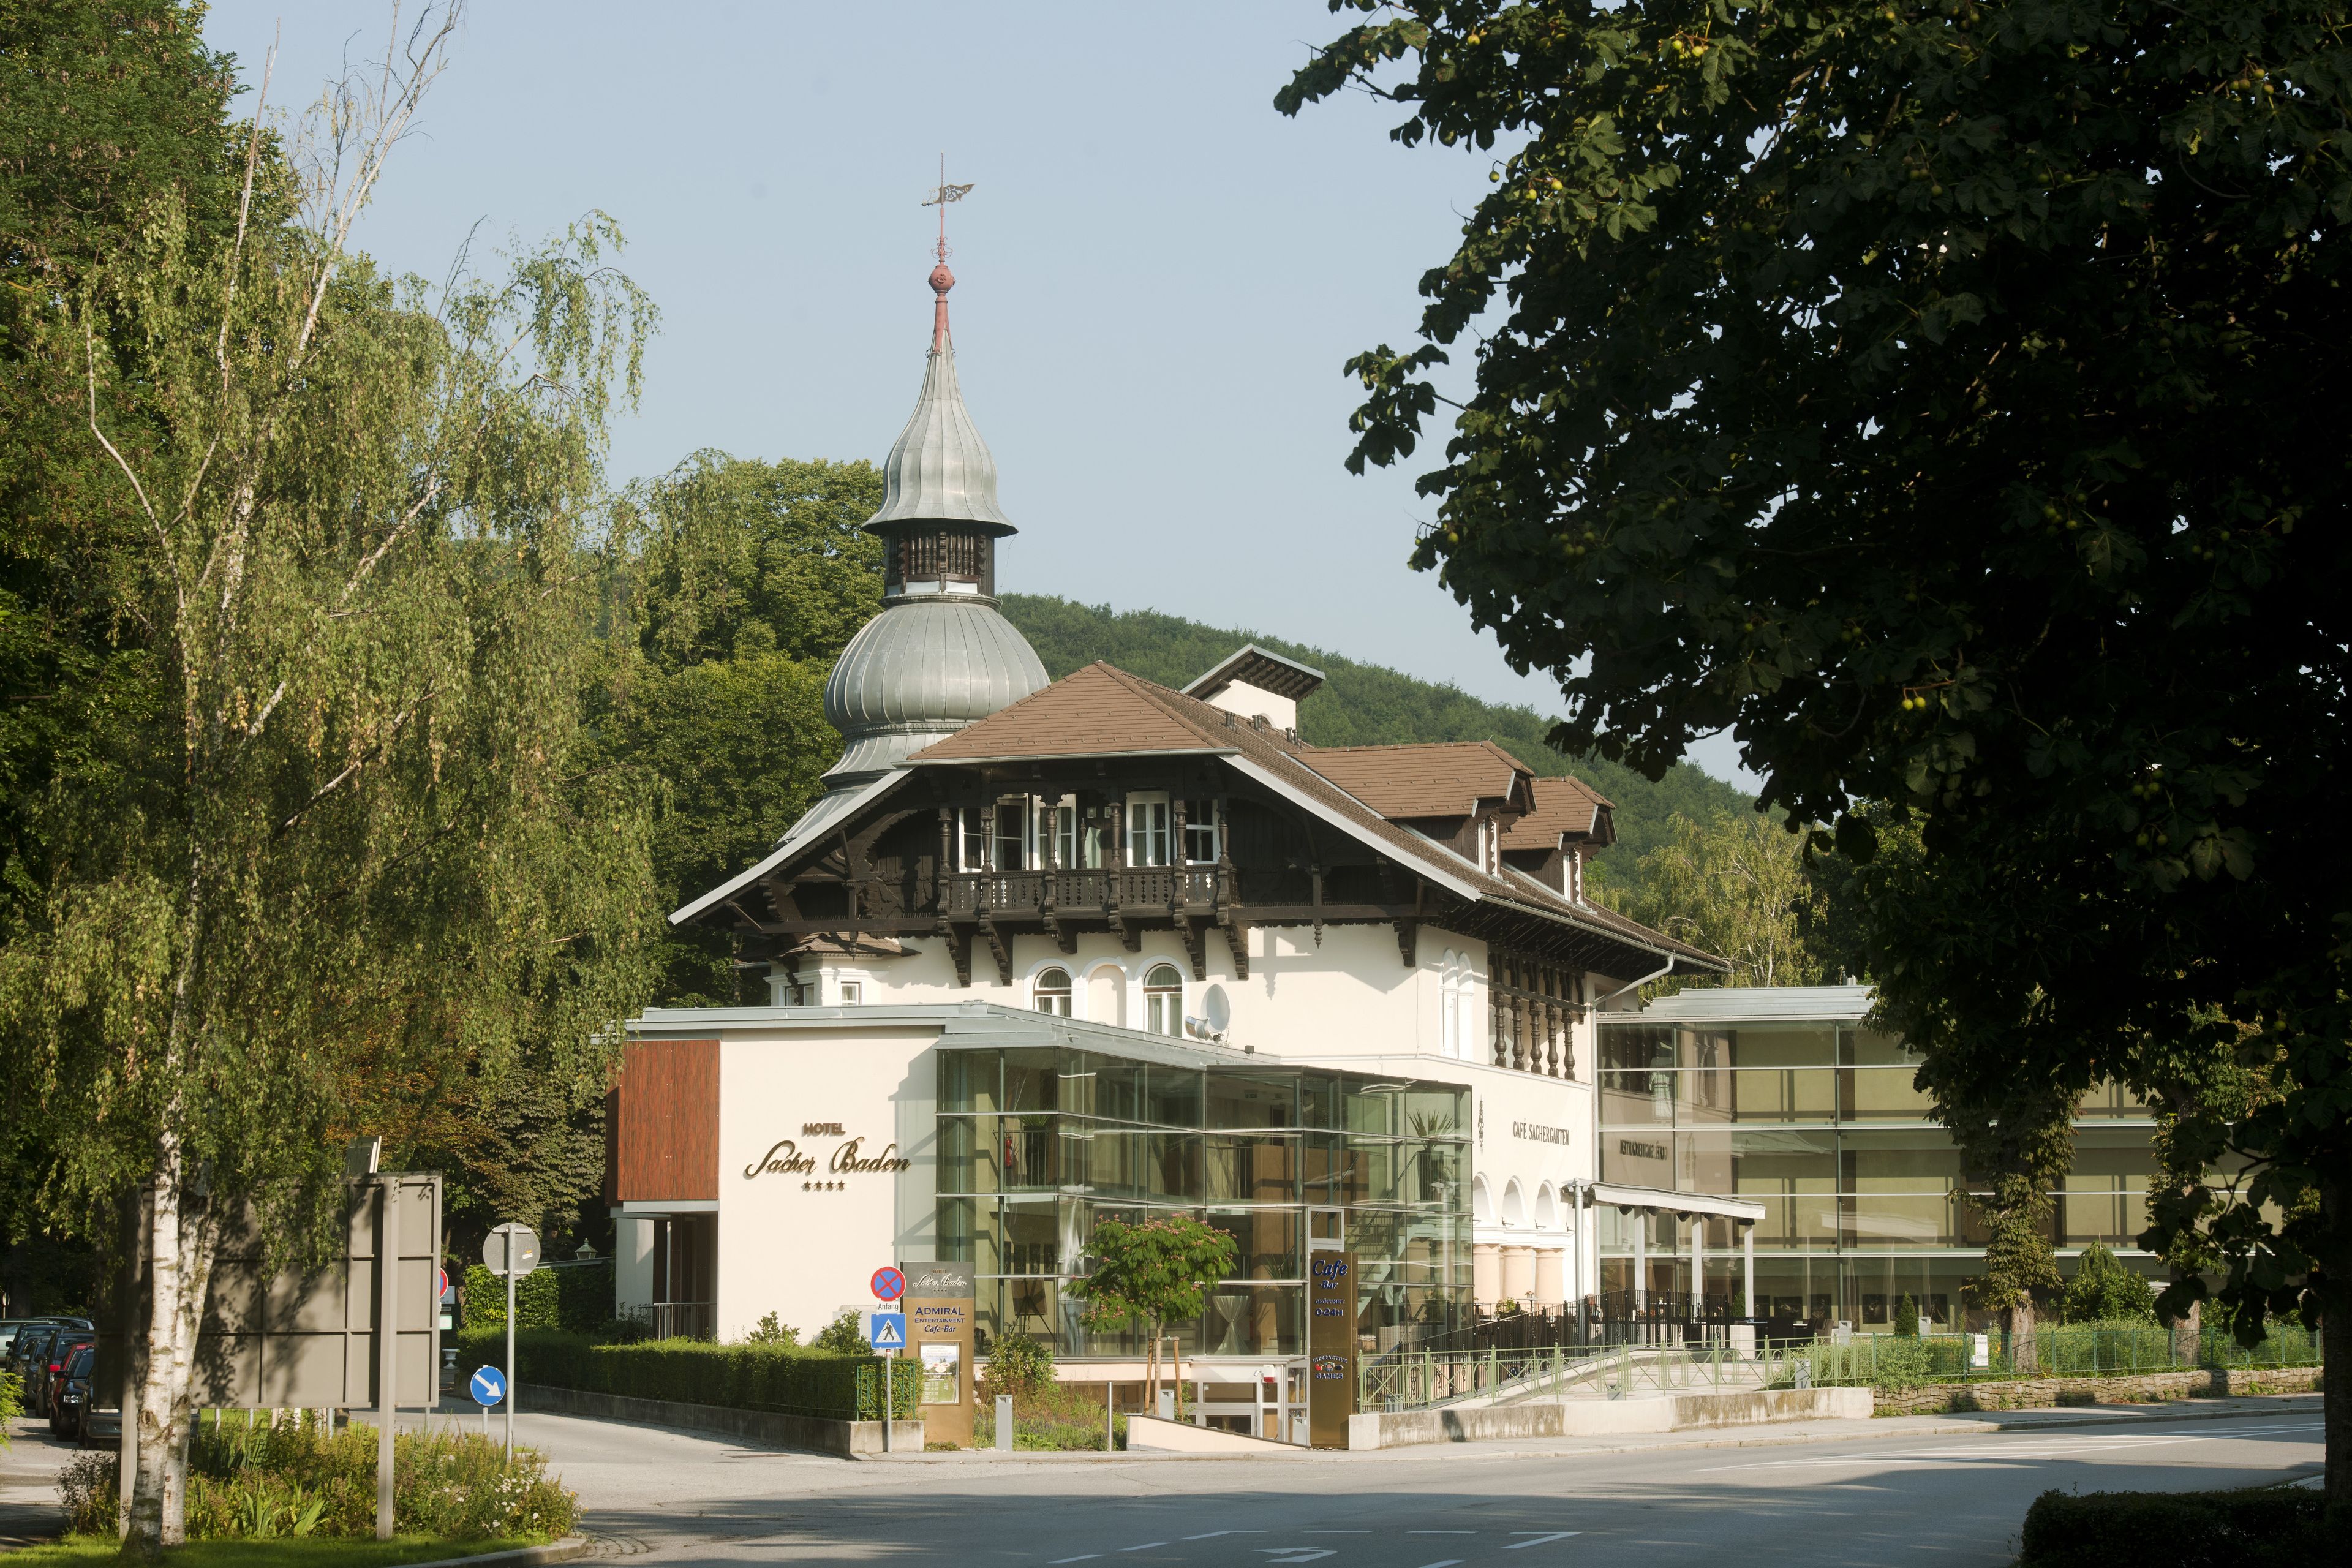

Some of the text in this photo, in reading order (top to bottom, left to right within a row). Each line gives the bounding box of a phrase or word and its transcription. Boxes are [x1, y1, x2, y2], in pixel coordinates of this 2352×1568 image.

[803, 1123, 846, 1135] HOTEL
[1513, 1118, 1569, 1145] CAFÉ SACHERGARTEN
[745, 1136, 911, 1177] Sacher Baden
[913, 1273, 967, 1288] Sacher Baden
[878, 1303, 899, 1312] Anfang
[915, 1307, 965, 1316] ADMIRAL
[1313, 1355, 1348, 1364] INTERACTIVE
